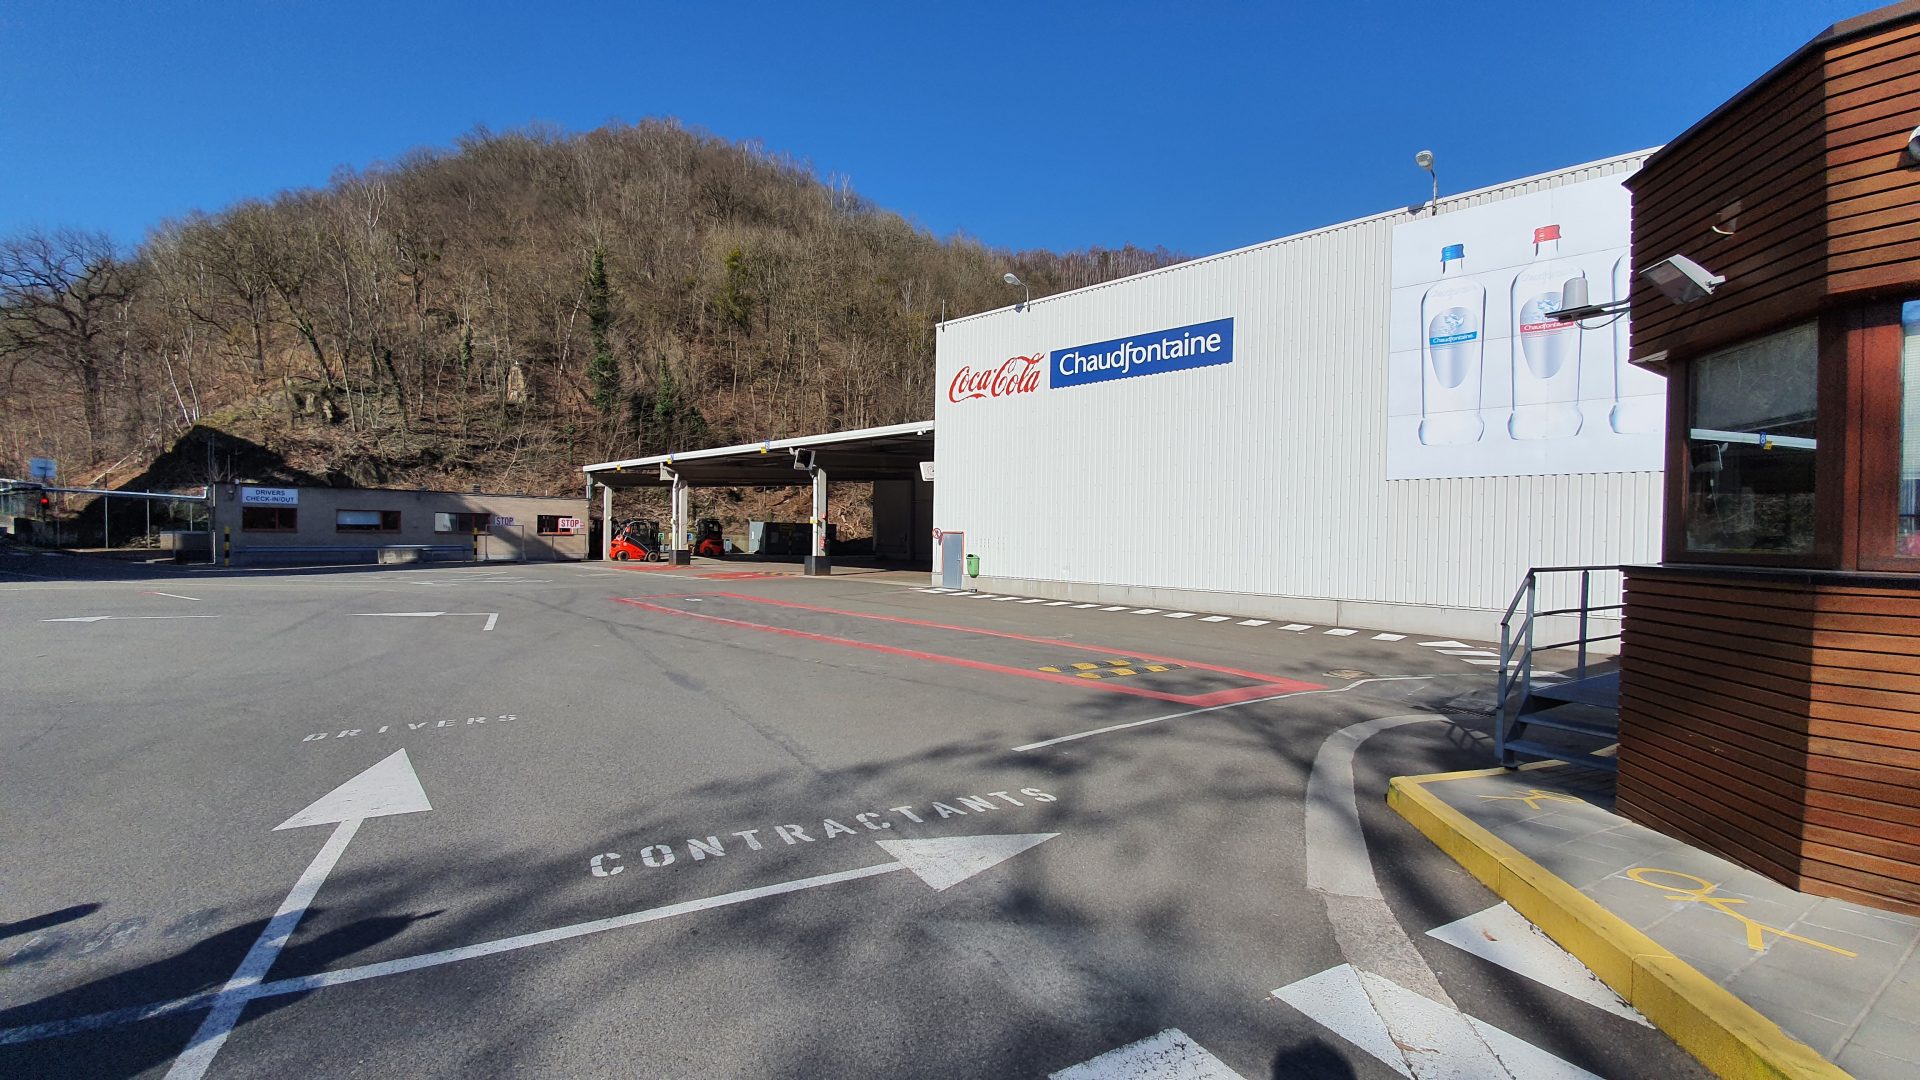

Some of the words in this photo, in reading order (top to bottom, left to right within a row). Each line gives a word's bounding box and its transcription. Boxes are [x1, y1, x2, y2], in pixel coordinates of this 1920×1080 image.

[1059, 332, 1221, 373] Chaudfontaine
[949, 352, 1045, 403] Coca-Cola
[245, 495, 294, 503] CHECK-IN/OUT
[496, 517, 514, 526] STOP
[560, 519, 580, 528] STOP
[302, 714, 518, 742] DRIVERS
[590, 787, 1057, 878] CONTRACTANTS
